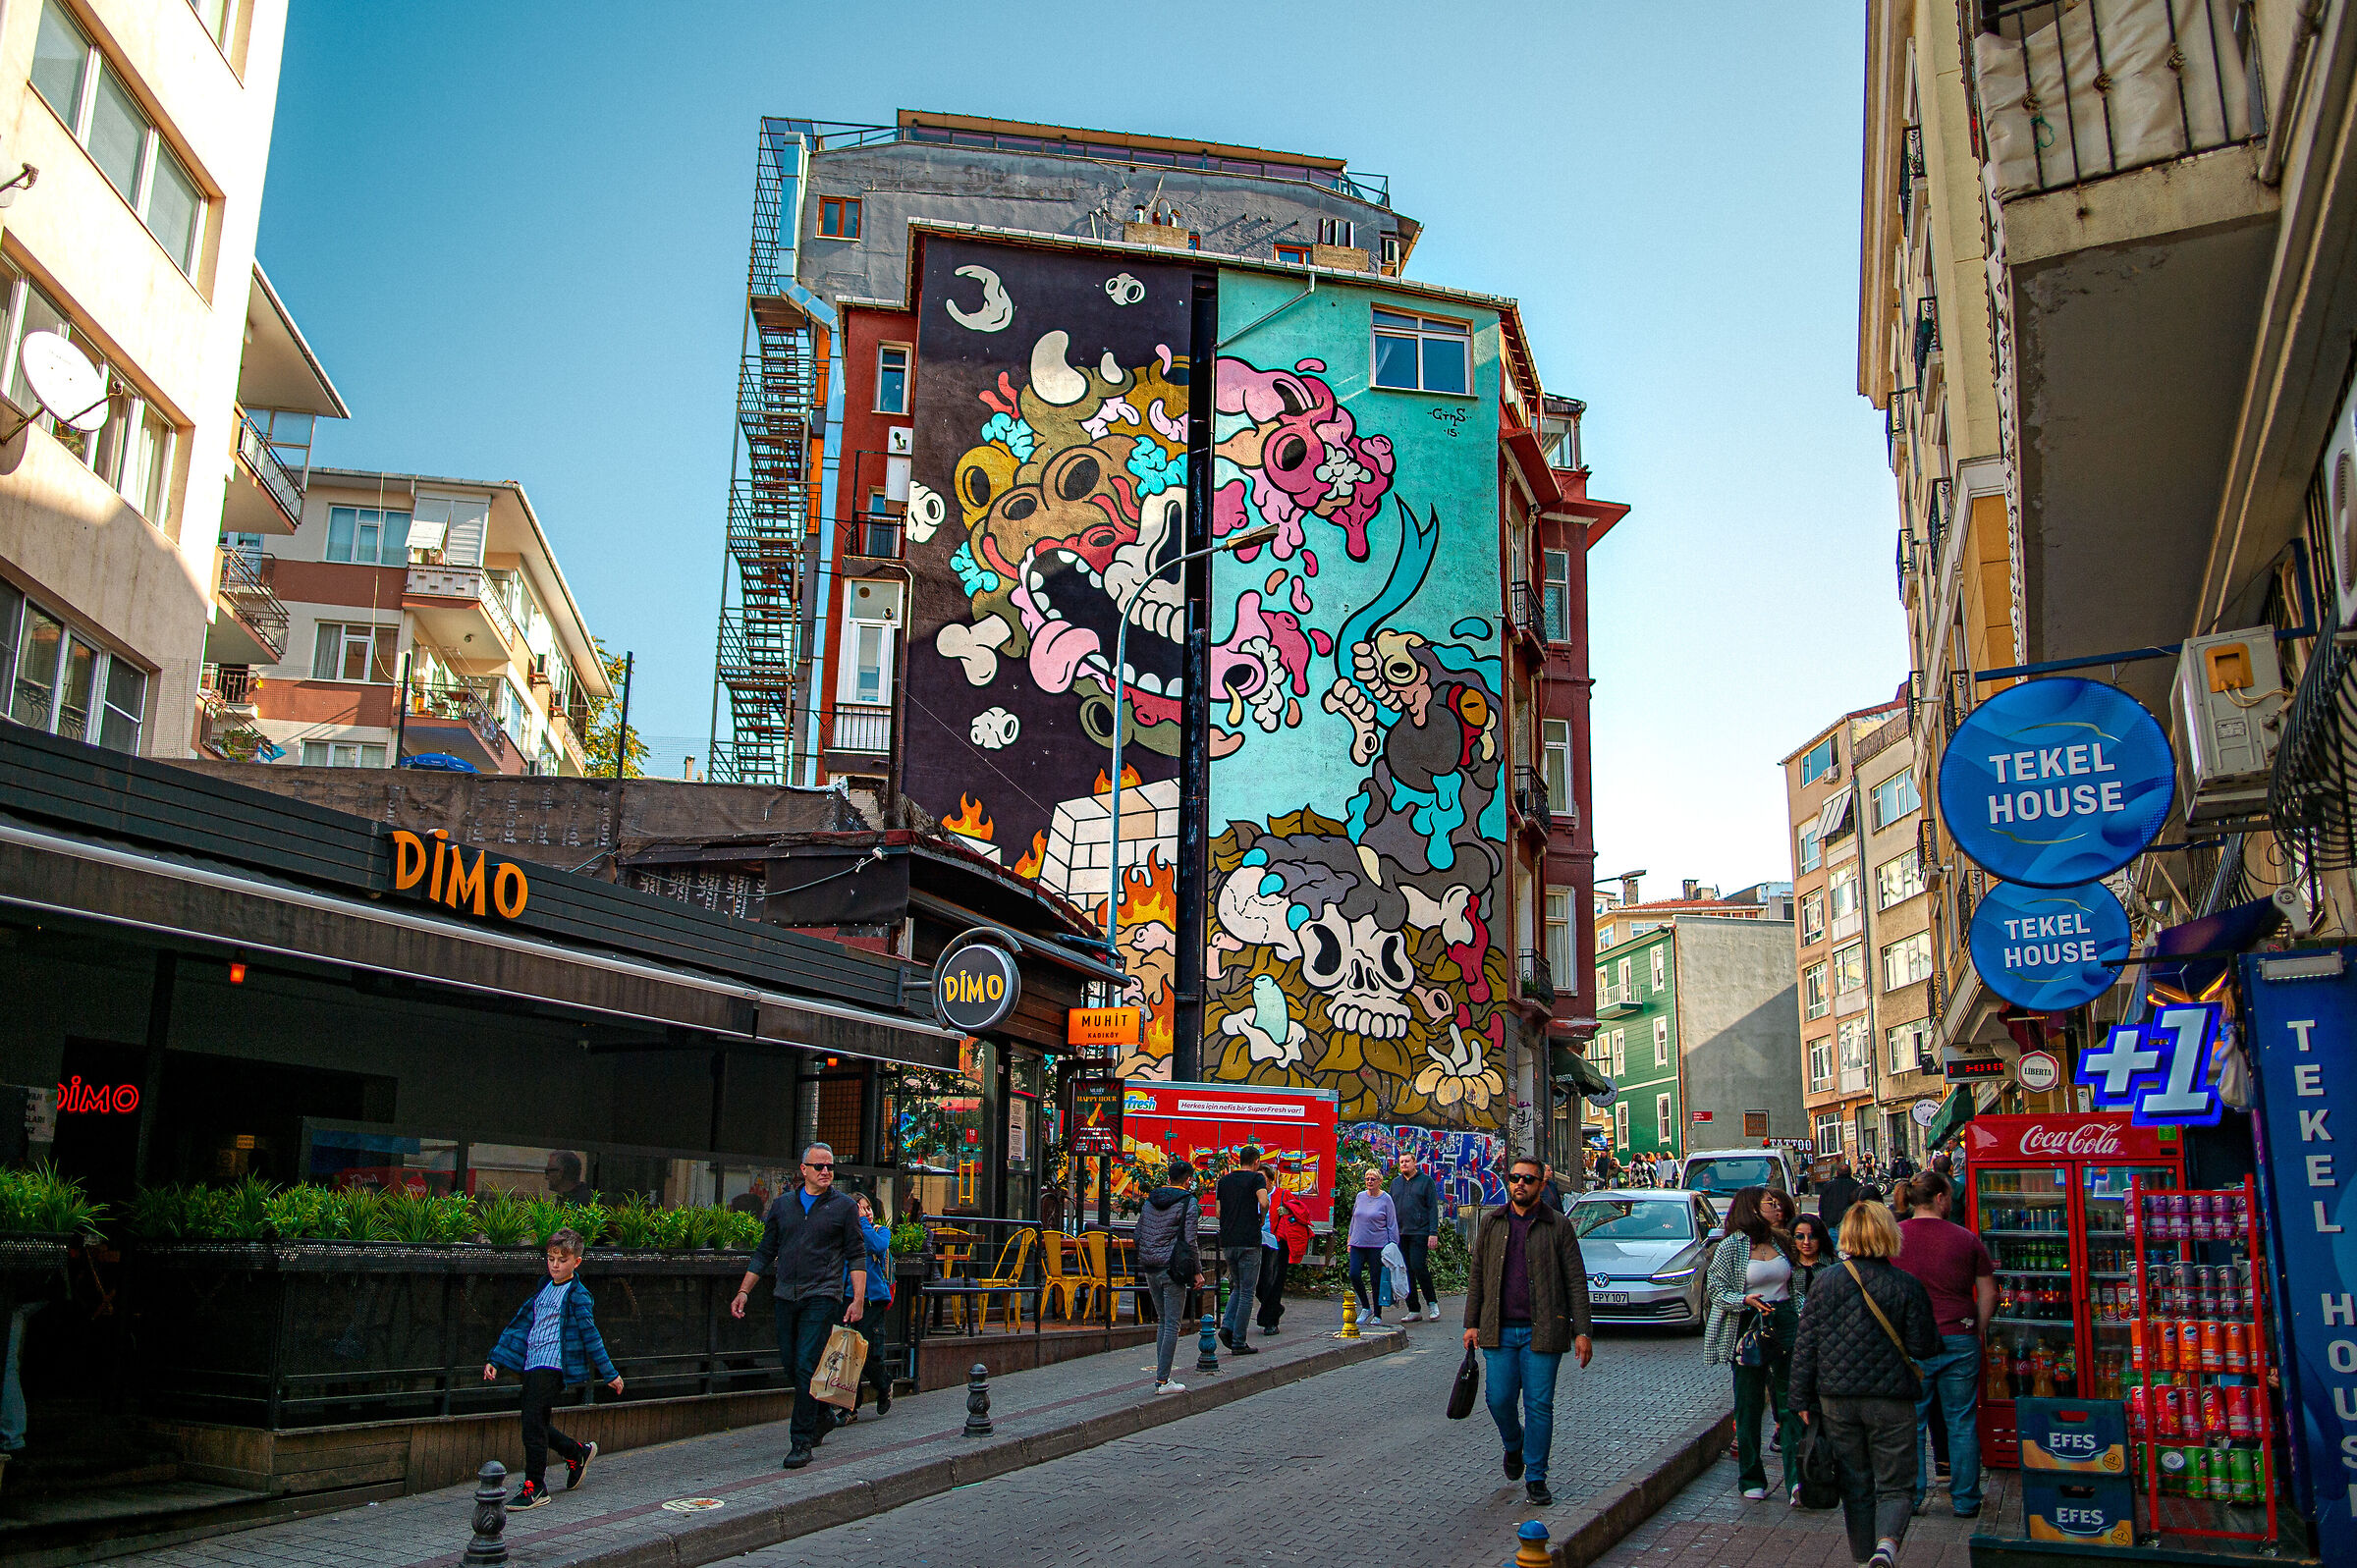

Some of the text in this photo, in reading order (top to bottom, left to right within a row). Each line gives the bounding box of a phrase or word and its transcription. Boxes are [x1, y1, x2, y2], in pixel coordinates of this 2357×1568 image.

[1989, 743, 2115, 784] TEKEL
[1988, 782, 2125, 825] HOUSE
[392, 829, 529, 919] DİMO
[2004, 914, 2091, 940] TEKEL
[2003, 941, 2099, 968] HOUSE
[944, 970, 1004, 1003] DİMO
[1081, 1014, 1127, 1028] MUHİT
[1124, 1095, 1157, 1110] rFresh
[2286, 1020, 2344, 1232] TEKEL
[1769, 1138, 1813, 1151] TATTOO
[1593, 1293, 1626, 1302] EPY 107
[2049, 1433, 2097, 1449] EFES
[2056, 1507, 2105, 1525] EFES
